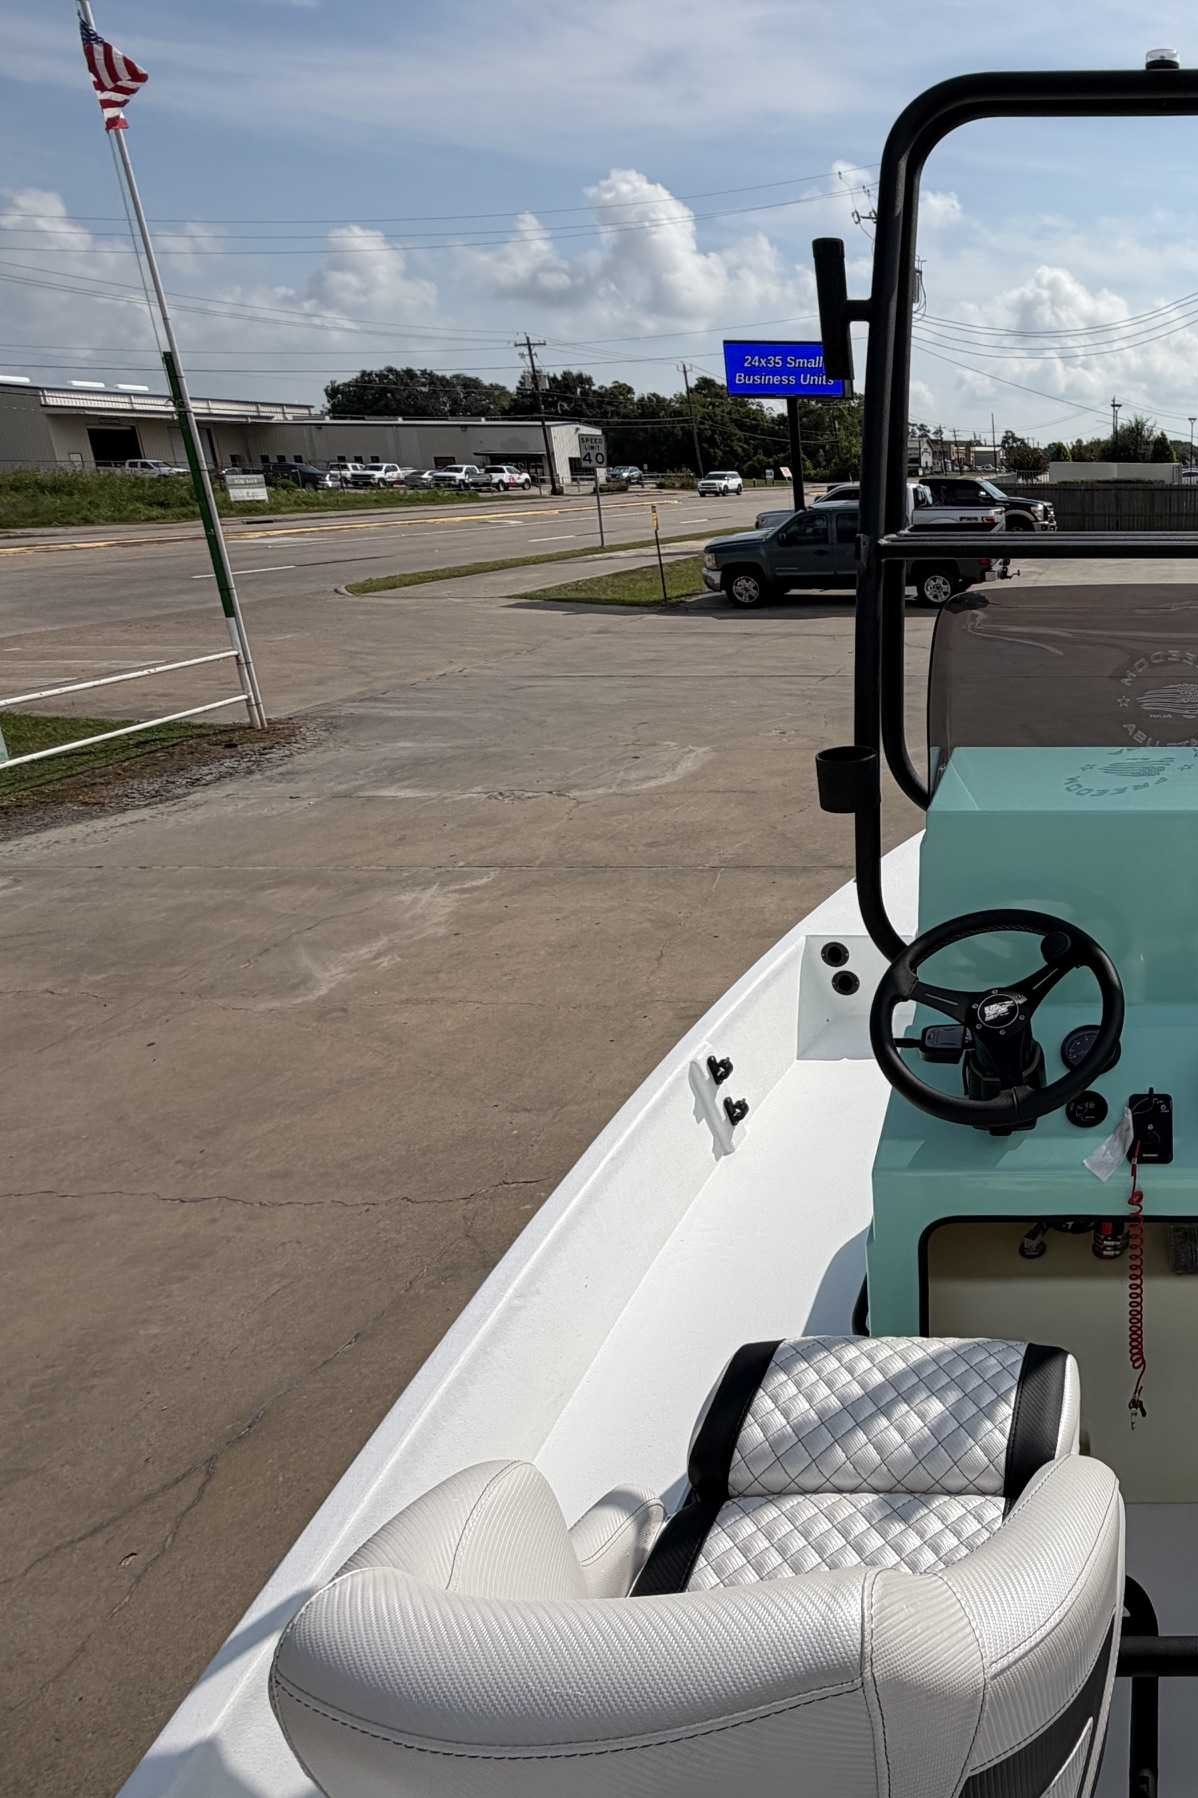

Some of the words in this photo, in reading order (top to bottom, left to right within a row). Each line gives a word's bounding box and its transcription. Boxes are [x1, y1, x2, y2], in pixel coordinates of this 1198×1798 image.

[744, 355, 783, 368] 24x35
[786, 356, 824, 368] Small
[735, 372, 796, 385] Business
[800, 373, 834, 386] Units
[582, 452, 605, 465] 40
